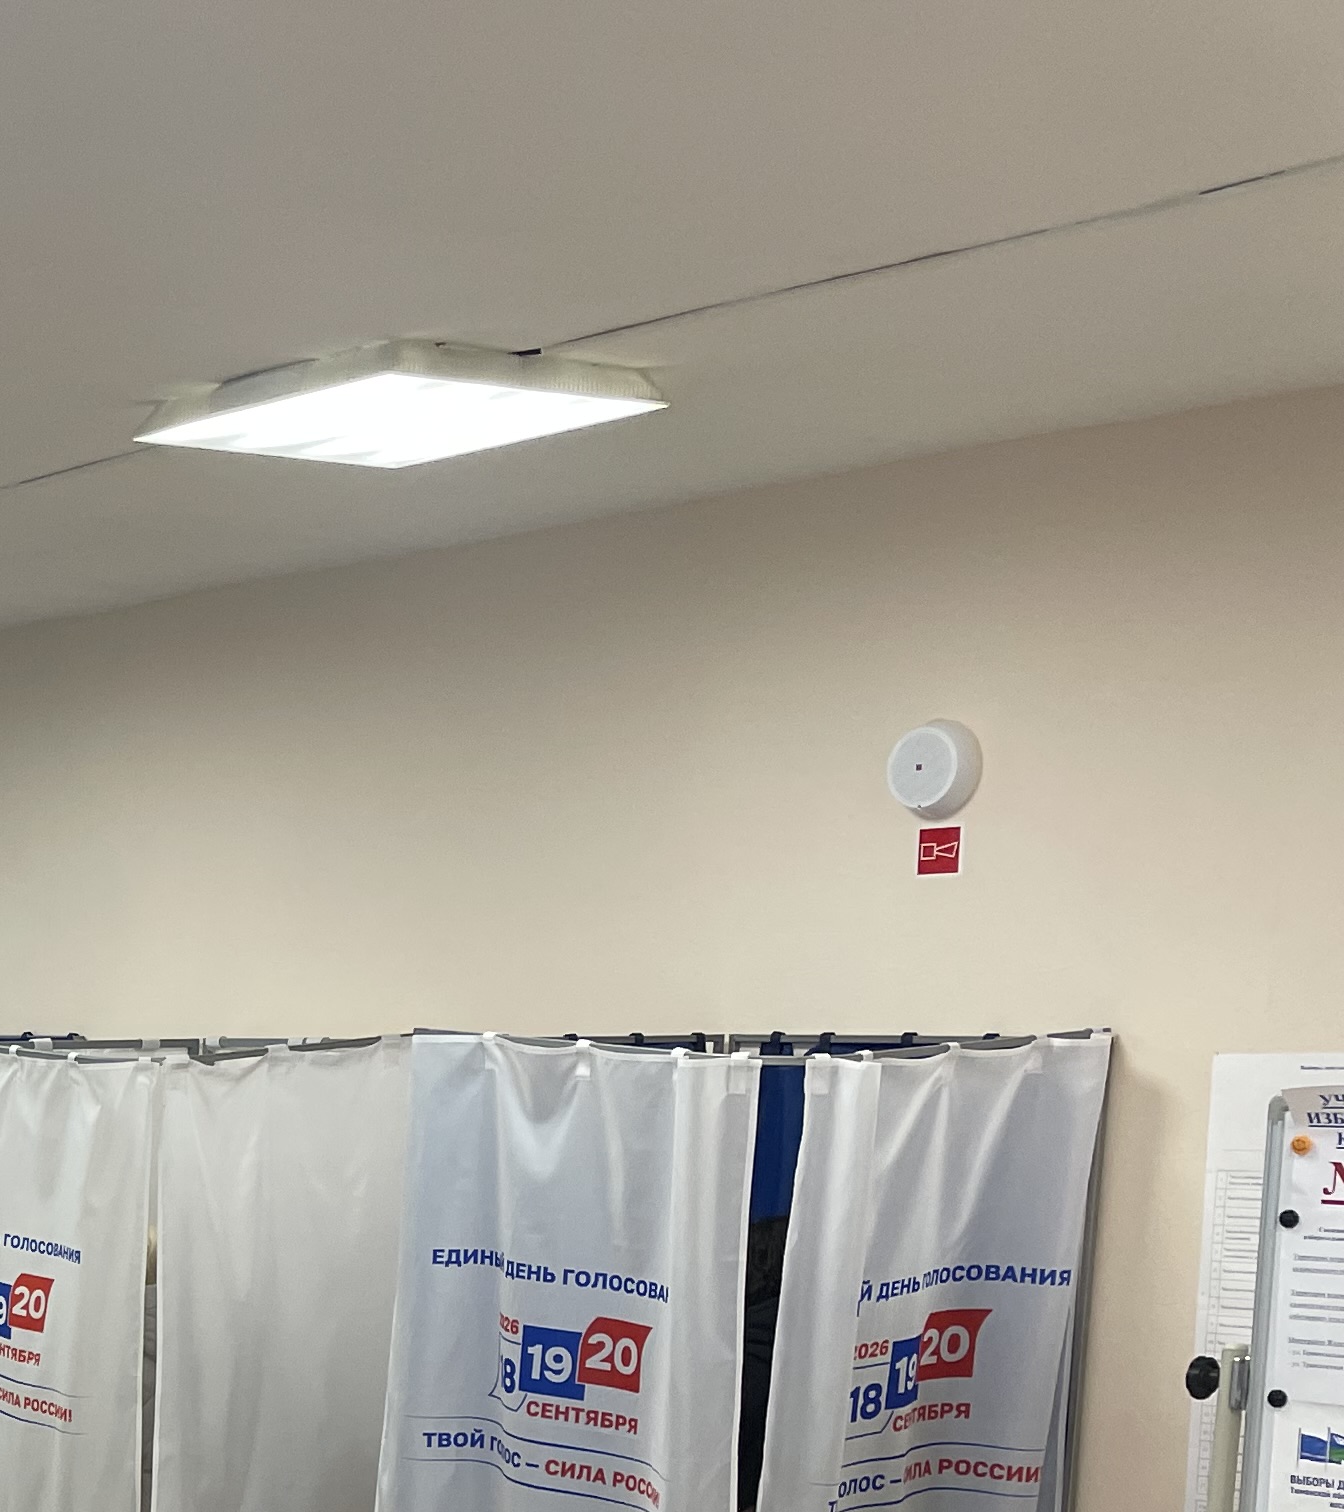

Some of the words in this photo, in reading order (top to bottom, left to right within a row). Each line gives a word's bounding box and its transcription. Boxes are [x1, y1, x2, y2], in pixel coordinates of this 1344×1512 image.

[4, 1233, 81, 1264] ГОЛОСОВАНИЯ
[506, 1260, 556, 1284] ДЕНЬ
[562, 1268, 669, 1304] ГОЛОСОВА
[876, 1279, 921, 1303] ДЕНЬ
[12, 1285, 46, 1320] 20
[527, 1344, 573, 1383] 19
[584, 1332, 638, 1376] 20
[849, 1383, 883, 1423] 18
[919, 1325, 971, 1367] 20
[23, 1397, 73, 1422] РОССИИ!
[525, 1400, 639, 1435] СЕНТЯБРЯ
[422, 1428, 485, 1449] ТВОЙ
[544, 1459, 607, 1486] СИЛА
[838, 1474, 885, 1499] ОЛОС
[903, 1459, 932, 1485] ИЛА
[938, 1458, 1041, 1484] РОССИИ
[1290, 1475, 1334, 1489] ВЫБОРЫ
